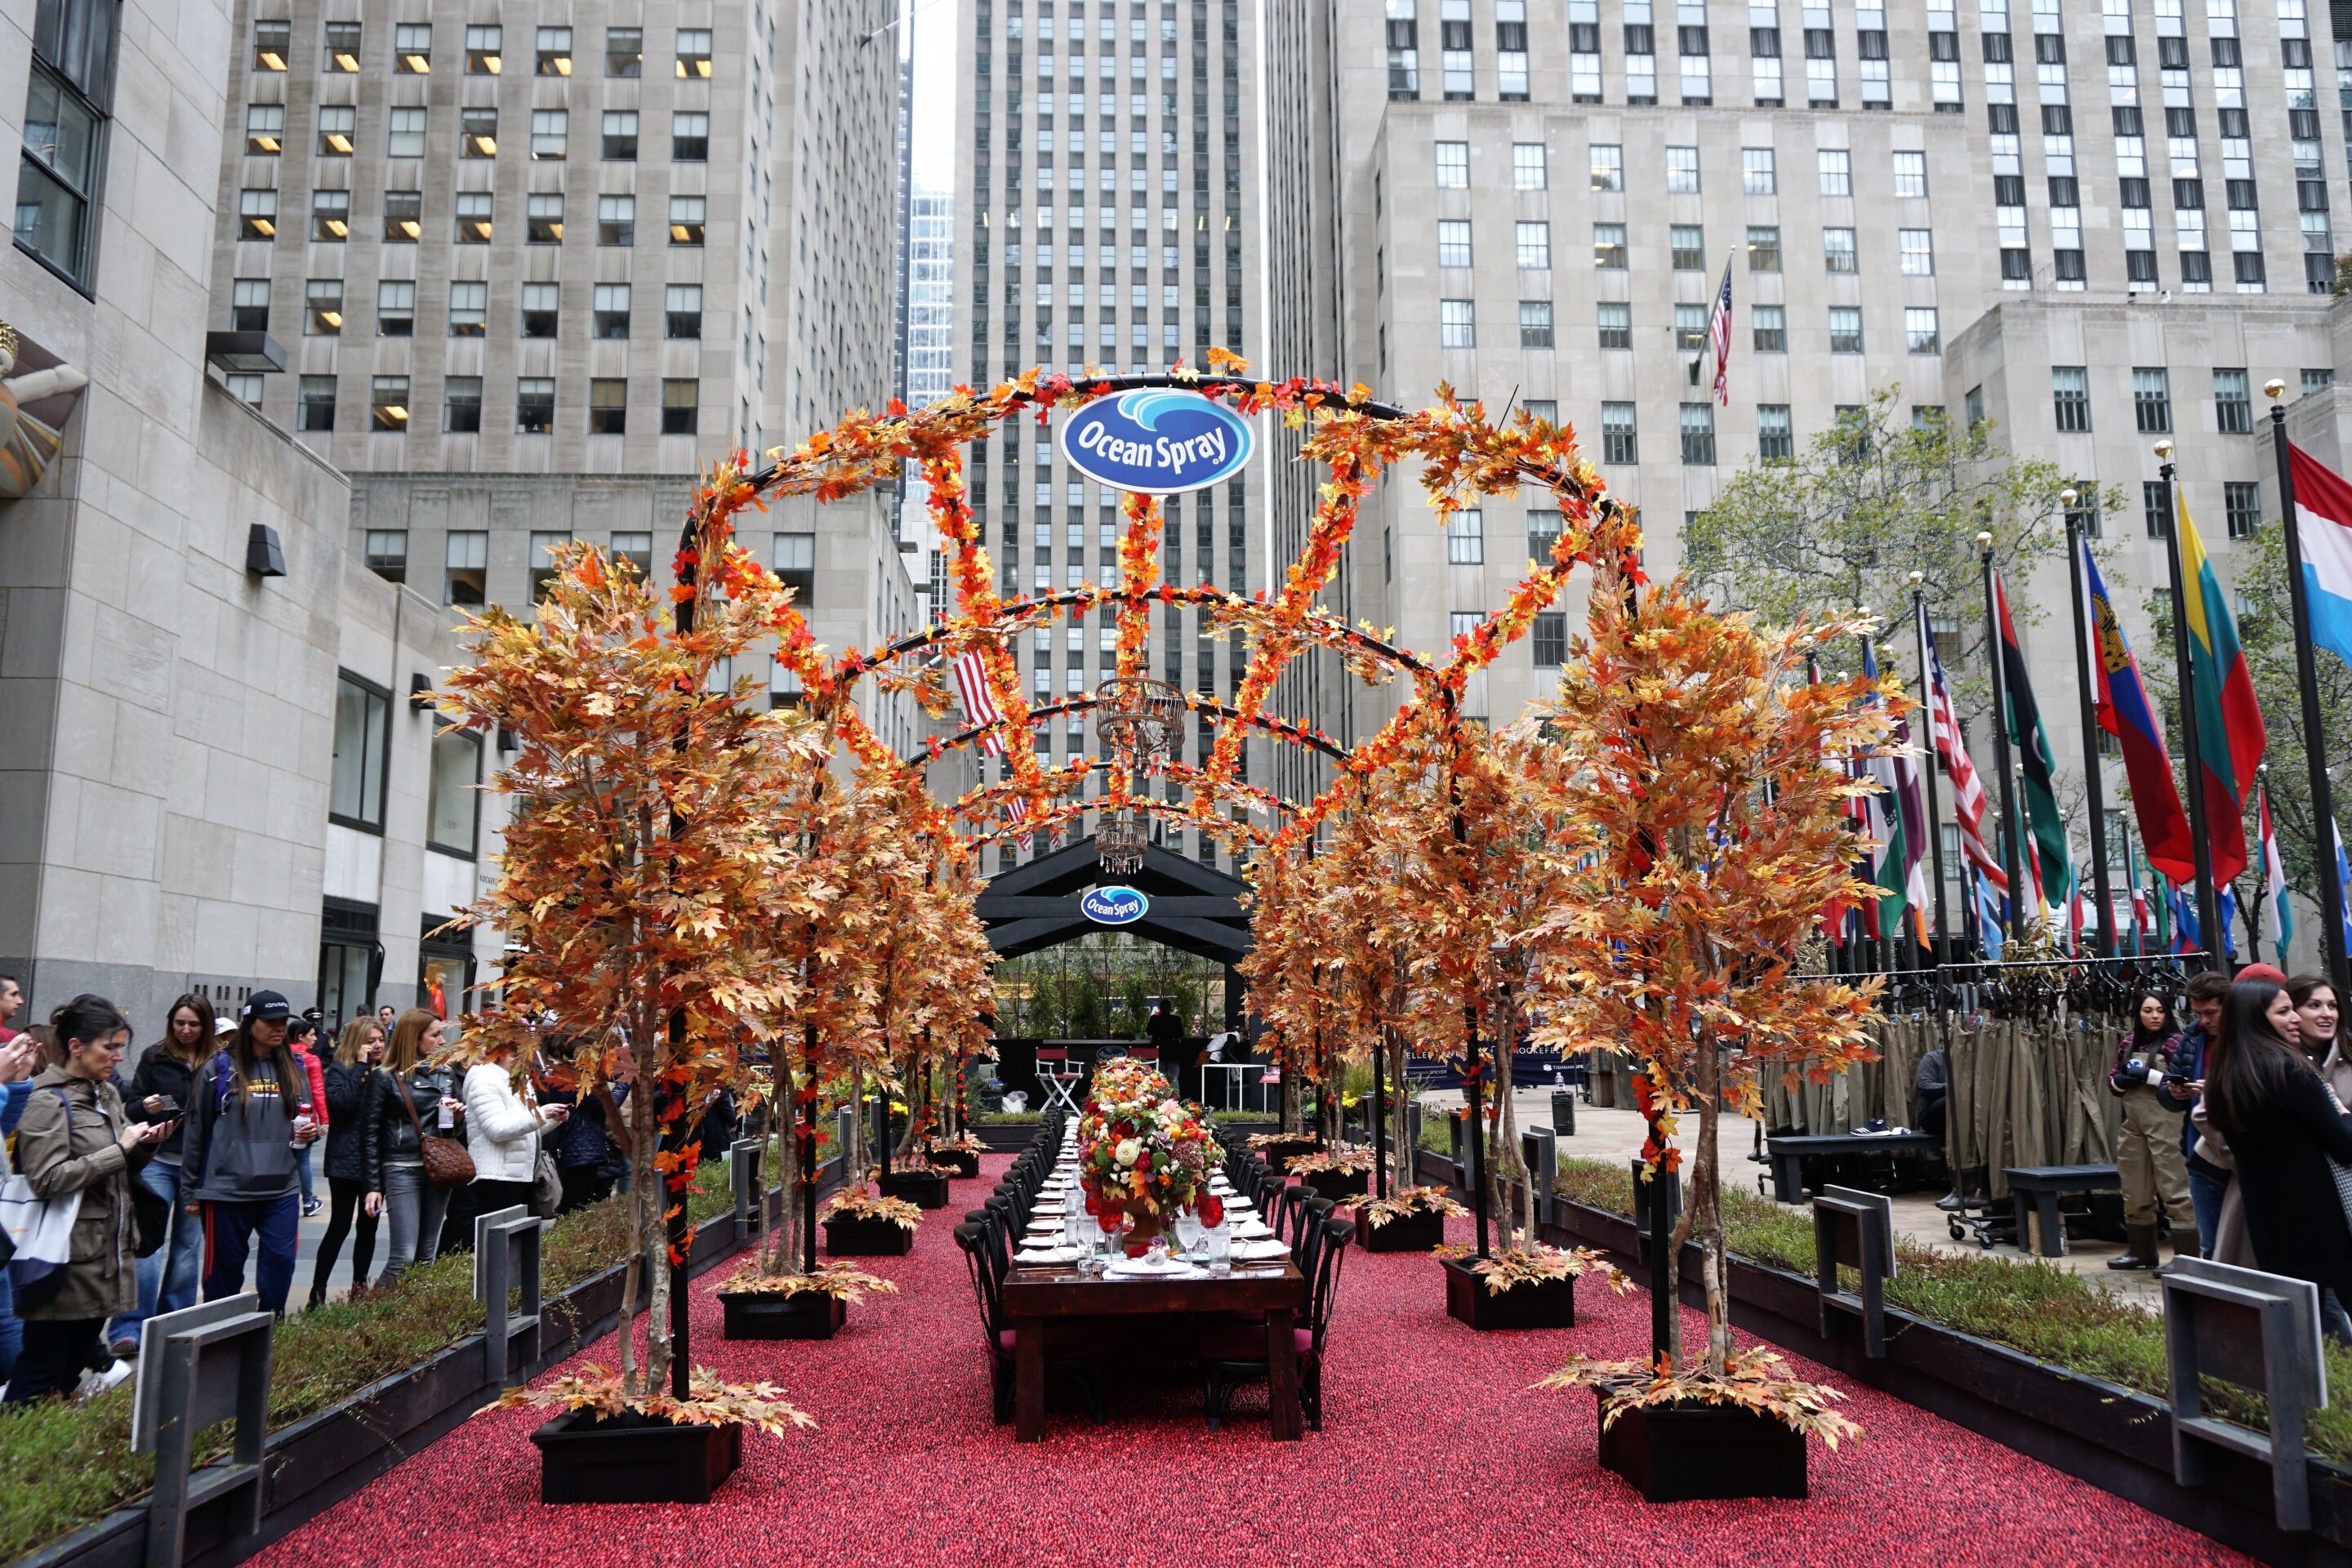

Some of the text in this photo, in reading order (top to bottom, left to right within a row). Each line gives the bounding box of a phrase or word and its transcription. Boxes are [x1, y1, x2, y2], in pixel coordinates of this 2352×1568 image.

[1078, 421, 1226, 474] Ocean Spray
[1087, 898, 1139, 918] Ocean Spray
